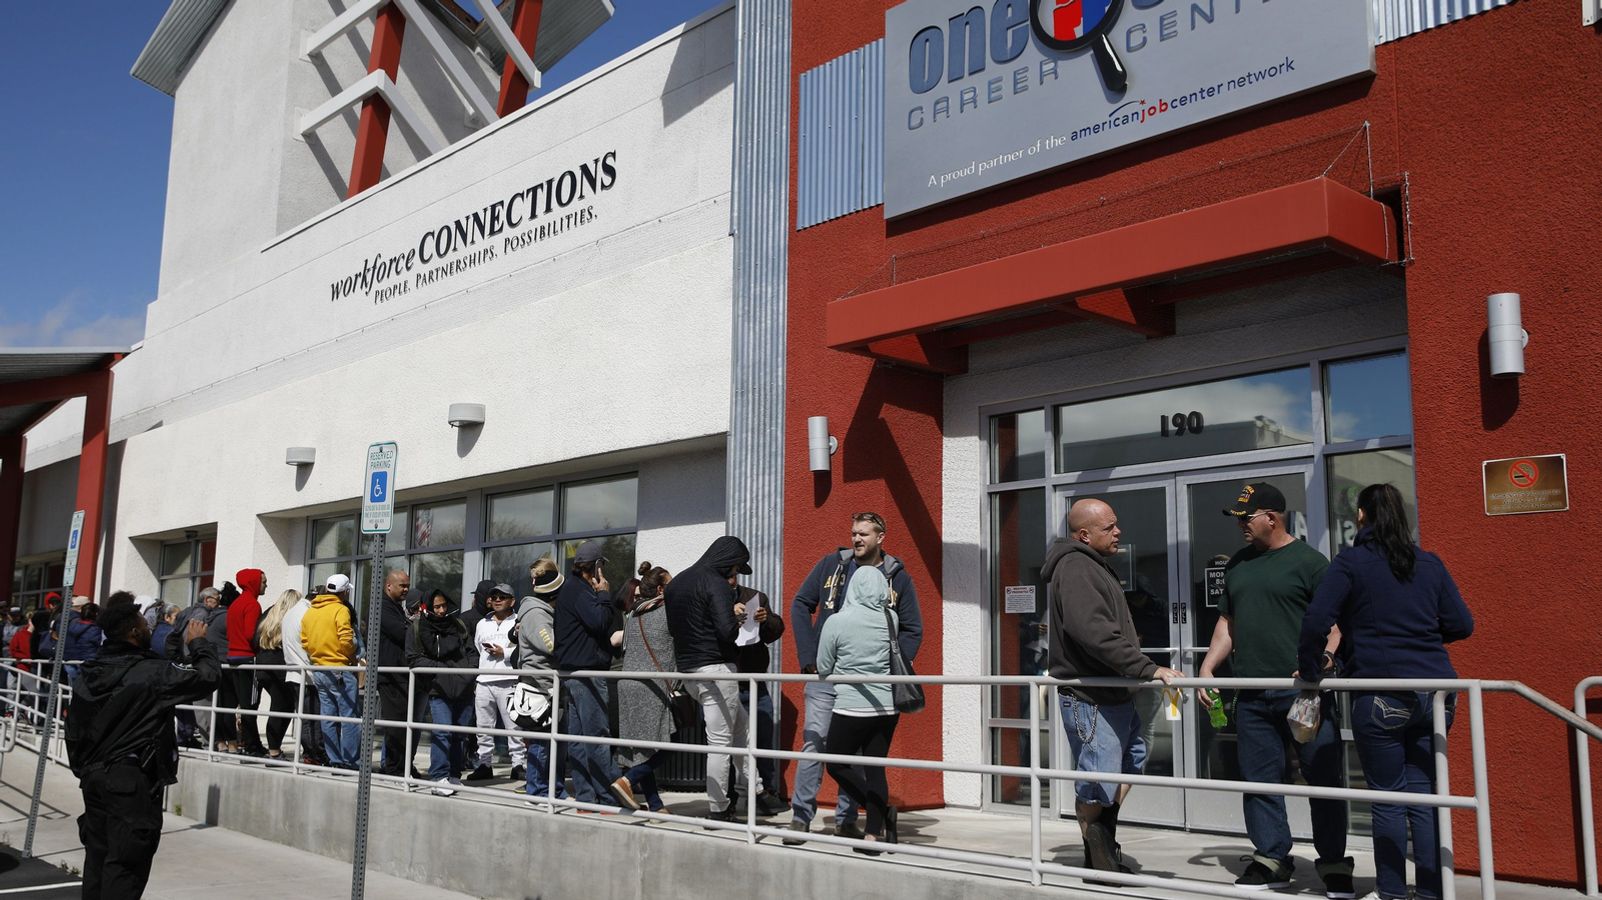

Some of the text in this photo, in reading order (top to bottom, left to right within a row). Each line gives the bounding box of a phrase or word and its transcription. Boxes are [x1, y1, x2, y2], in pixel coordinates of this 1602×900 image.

[907, 0, 1271, 130] CAREER CEN
[908, 0, 1030, 95] one
[927, 175, 937, 188] A
[940, 161, 976, 186] proud
[978, 149, 1025, 176] partner
[1027, 139, 1042, 156] of
[1045, 135, 1067, 150] the
[1227, 56, 1296, 92] network
[330, 149, 618, 302] workforce CONNECTIONS
[370, 450, 394, 461] RESERVED
[370, 459, 392, 470] PARKING
[1160, 411, 1205, 438] 190
